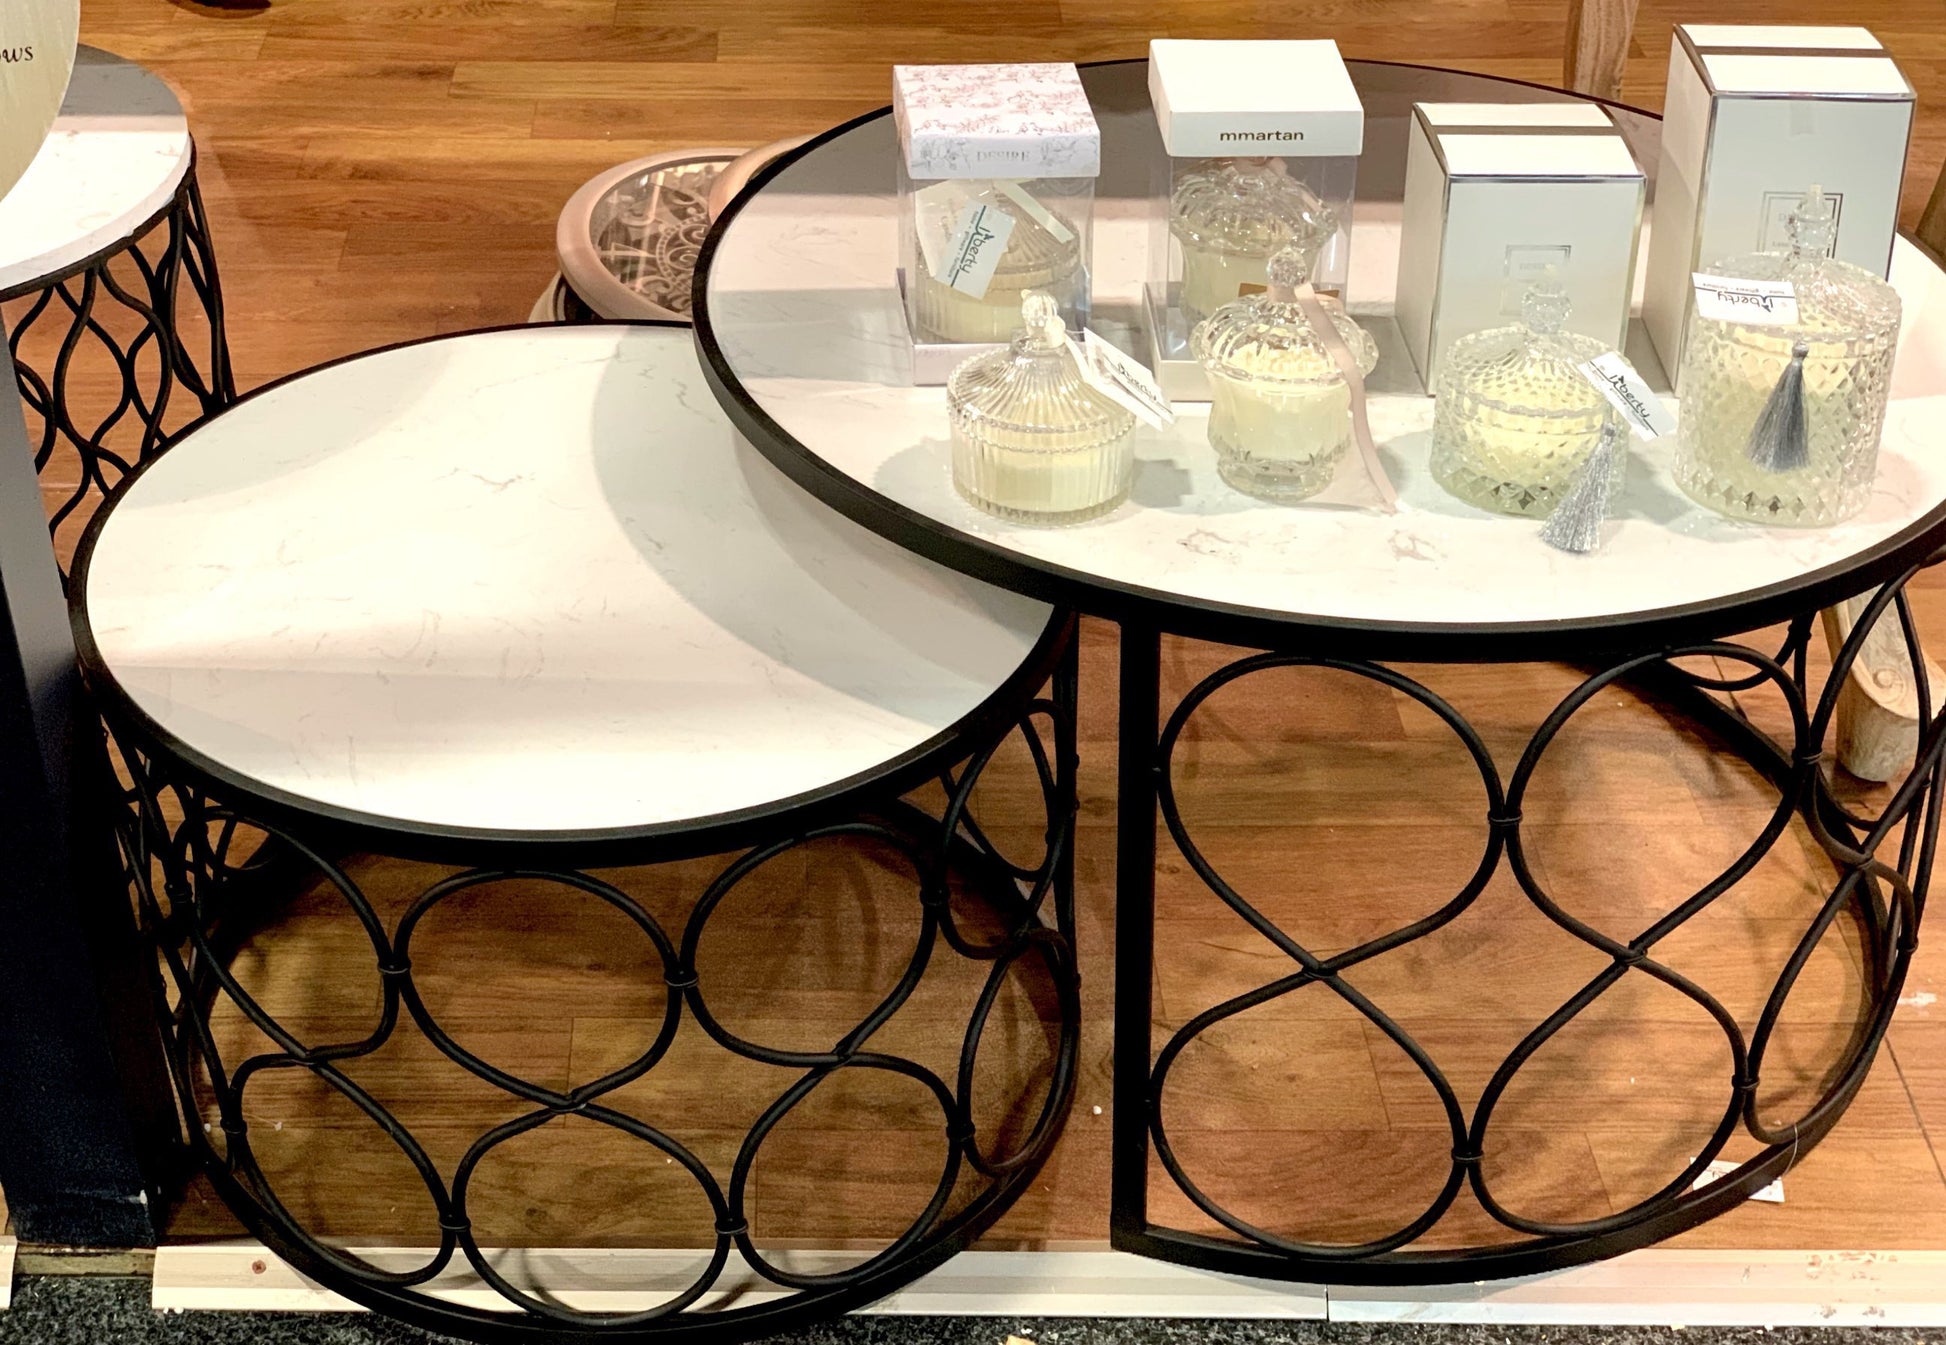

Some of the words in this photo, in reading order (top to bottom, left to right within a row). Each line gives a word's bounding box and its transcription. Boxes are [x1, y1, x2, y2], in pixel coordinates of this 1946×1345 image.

[1220, 130, 1304, 141] mmartan
[959, 225, 995, 274] liberty
[1717, 291, 1774, 313] liberty
[1609, 374, 1650, 419] liberty
